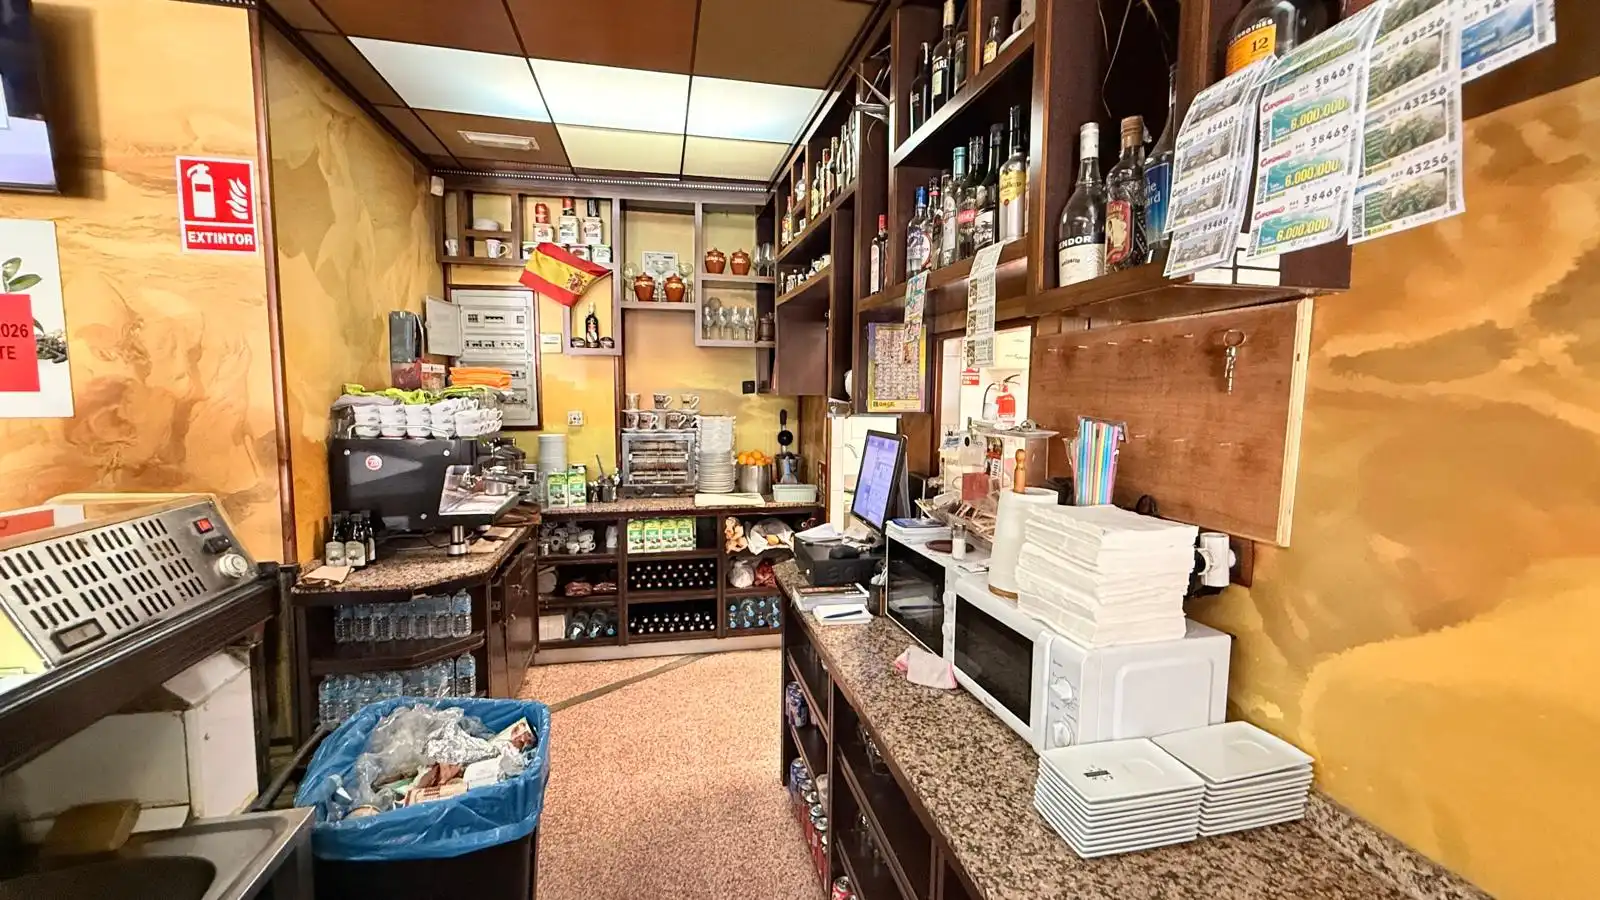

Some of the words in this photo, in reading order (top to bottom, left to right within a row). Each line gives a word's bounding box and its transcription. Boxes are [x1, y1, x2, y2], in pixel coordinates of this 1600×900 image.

[1402, 17, 1445, 45] 43256
[1251, 37, 1269, 52] 12
[1315, 63, 1354, 88] 38469
[1403, 85, 1447, 110] 43256
[1310, 124, 1349, 147] 38469
[1406, 153, 1449, 176] 43256
[1304, 185, 1341, 204] 38469
[188, 230, 255, 246] EXTINTOR
